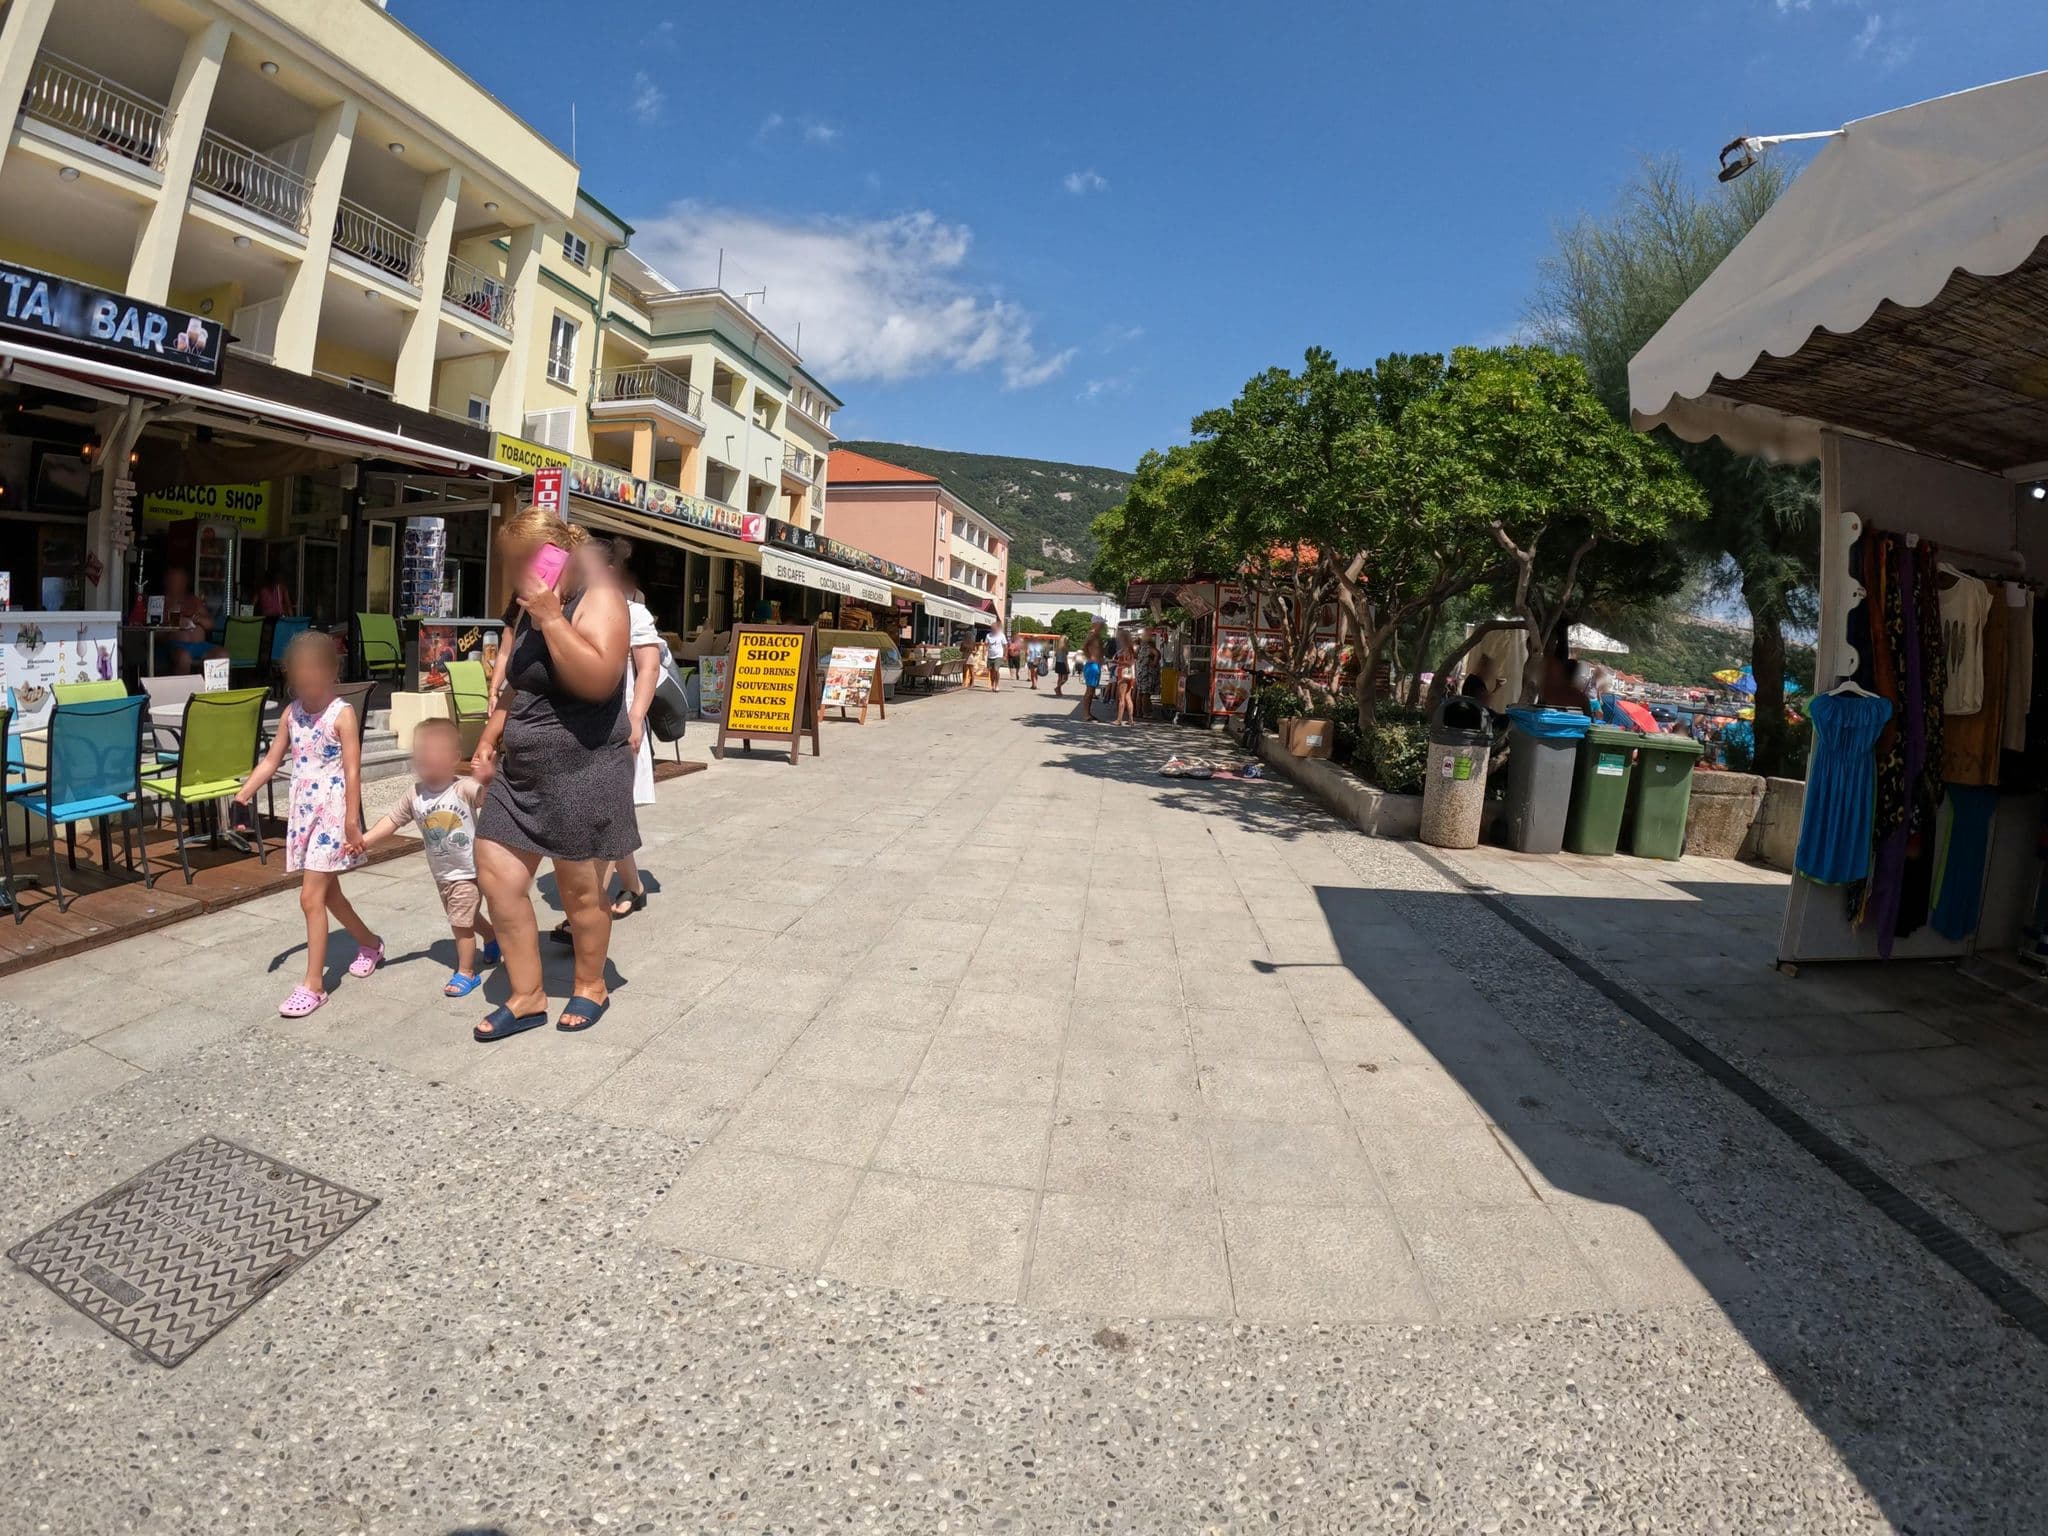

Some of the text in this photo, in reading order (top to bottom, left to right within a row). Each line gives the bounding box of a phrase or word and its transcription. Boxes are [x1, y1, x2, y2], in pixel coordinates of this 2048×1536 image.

[90, 298, 168, 353] BAR
[501, 443, 543, 468] TOBACCO
[225, 489, 263, 511] SHOP
[458, 626, 482, 652] BEER
[742, 636, 799, 648] TOBACCO
[747, 650, 790, 661] SHOP
[738, 666, 796, 676] COLD DRINKS
[736, 681, 794, 691] SOUVENIRS
[739, 695, 786, 706] SNACKS
[733, 709, 790, 720] NEWSPAPER
[150, 1208, 236, 1257] KANALIZACIJA
